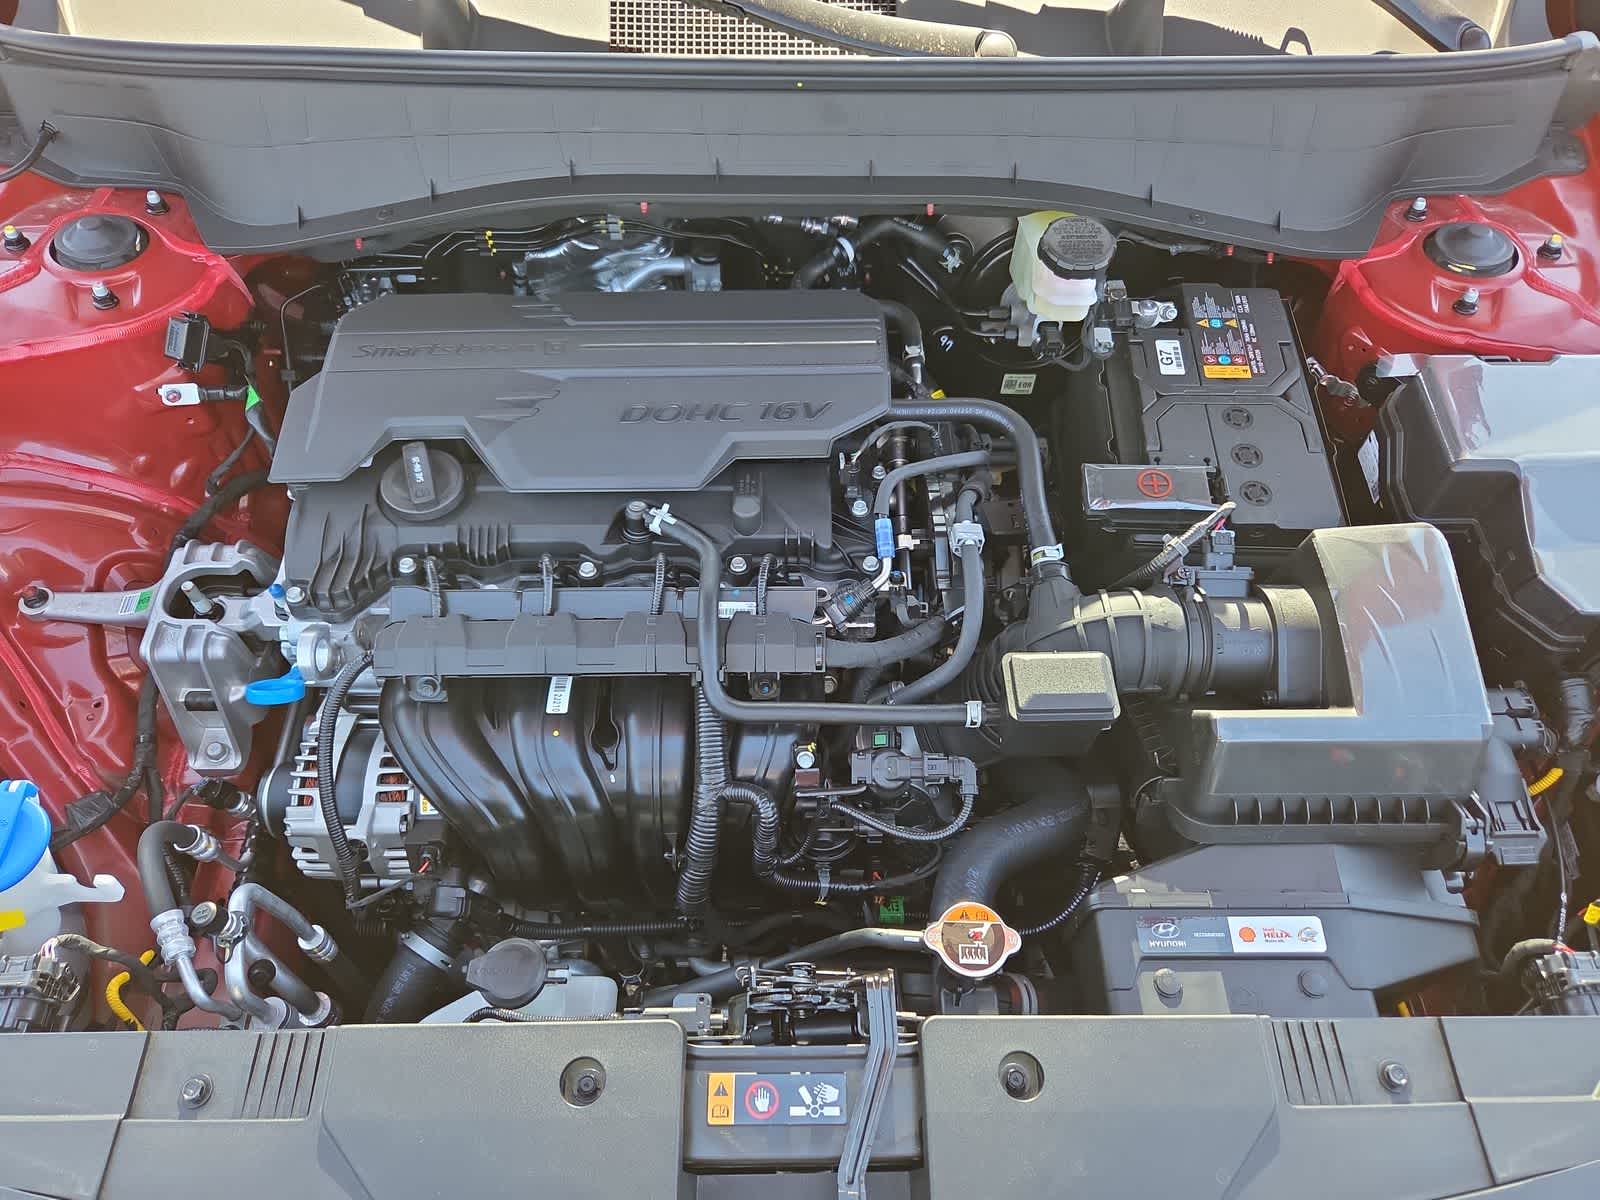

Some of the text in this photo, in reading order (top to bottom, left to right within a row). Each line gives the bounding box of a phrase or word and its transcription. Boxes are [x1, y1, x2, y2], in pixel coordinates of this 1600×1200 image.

[1160, 349, 1174, 366] G7
[619, 400, 833, 424] DOHC 16V
[1263, 931, 1292, 939] HELIX
[1149, 940, 1187, 949] HYUNDAI
